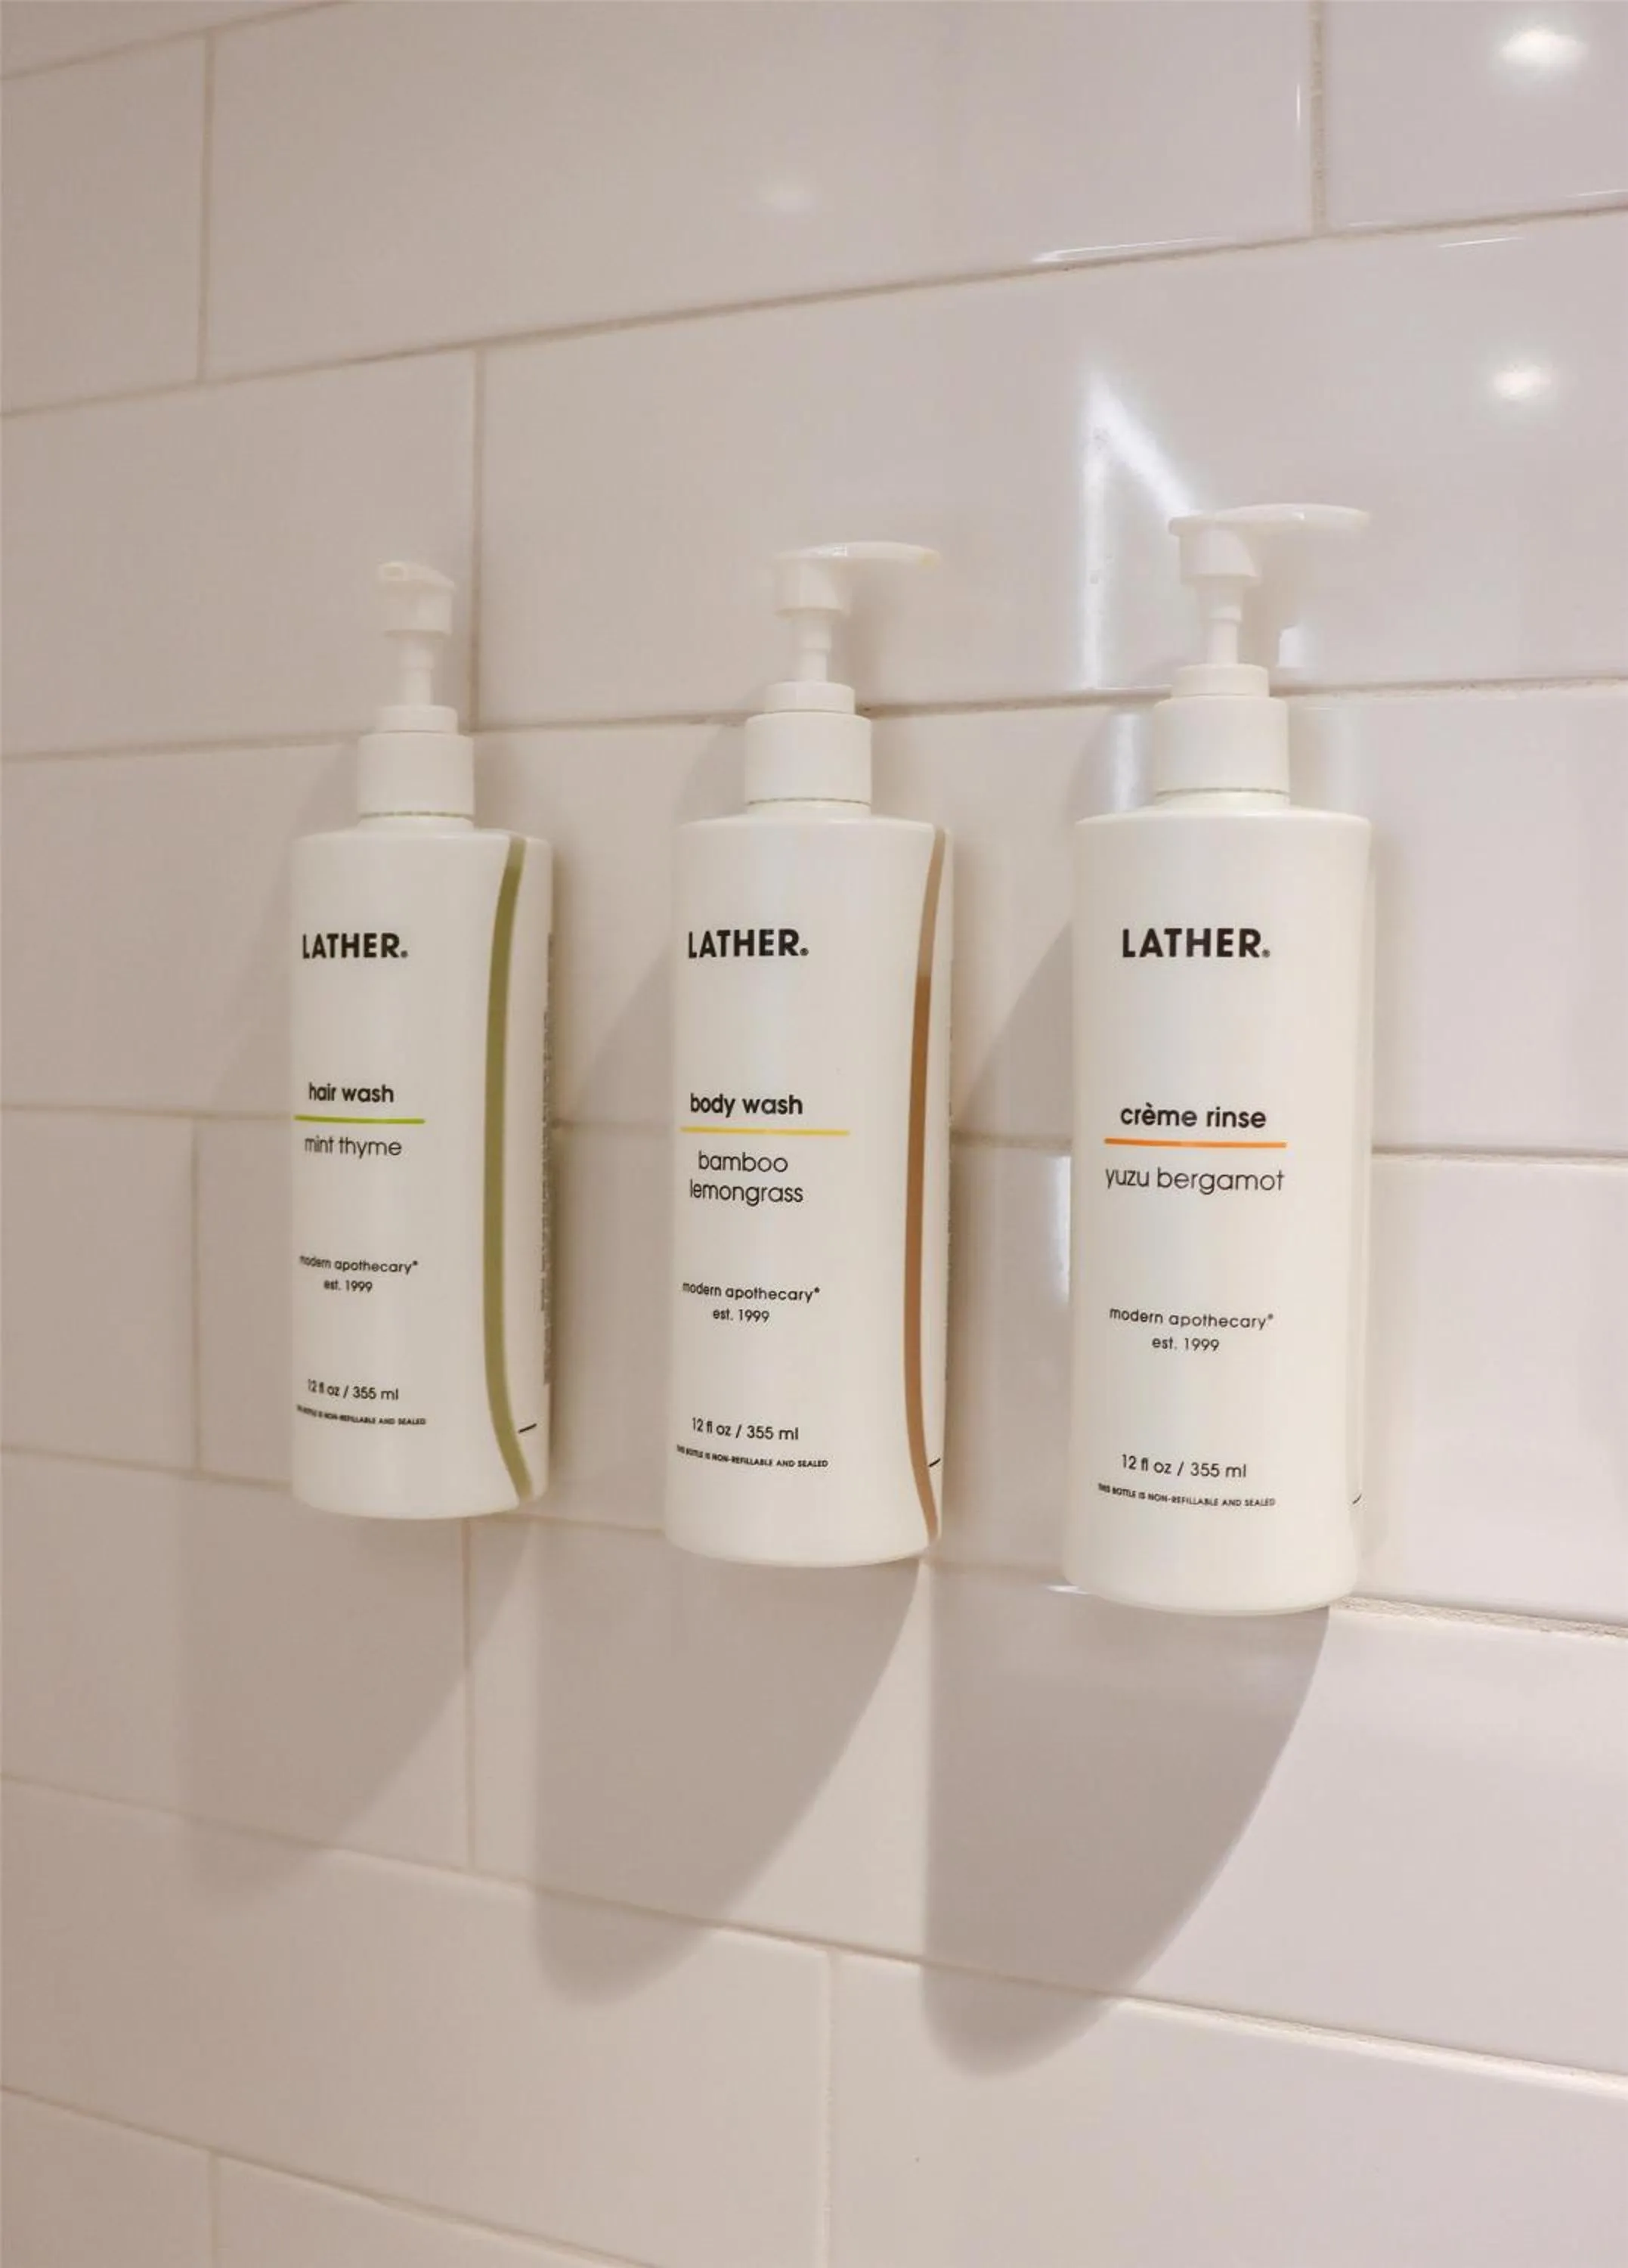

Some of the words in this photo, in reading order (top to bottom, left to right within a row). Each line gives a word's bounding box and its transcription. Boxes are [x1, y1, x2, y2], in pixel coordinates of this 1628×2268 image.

[308, 1082, 337, 1101] hair
[342, 1083, 395, 1103] wash
[690, 1092, 736, 1118] body
[741, 1094, 803, 1115] wash
[1120, 1101, 1198, 1127] crème
[1206, 1106, 1267, 1129] rinse
[305, 1135, 333, 1154] mint
[339, 1137, 402, 1159] thyme
[698, 1151, 788, 1173] bamboo
[1105, 1168, 1150, 1189] yuzu
[1157, 1167, 1285, 1195] bergamot
[689, 1179, 803, 1207] lemongrass
[345, 1280, 373, 1293] 1999
[682, 1281, 722, 1298] modern
[713, 1307, 733, 1321] est.
[738, 1309, 770, 1323] 1999
[1110, 1307, 1163, 1325] modern
[1152, 1336, 1178, 1350] est.
[1184, 1337, 1220, 1352] 1999
[327, 1384, 341, 1397] oz
[352, 1386, 377, 1399] 355
[381, 1388, 399, 1401] ml
[692, 1418, 703, 1432] 12
[716, 1424, 731, 1437] oz
[735, 1424, 742, 1439] /
[747, 1425, 774, 1439] 355
[778, 1427, 799, 1440] ml
[712, 1454, 773, 1467] NON-REFILLABLE
[776, 1459, 795, 1467] AND
[797, 1459, 829, 1467] SEALED
[1122, 1454, 1137, 1470] 12
[1153, 1461, 1171, 1474] oz
[1177, 1461, 1184, 1476] /
[1190, 1462, 1221, 1478] 355
[1225, 1464, 1246, 1478] ml
[1112, 1487, 1135, 1498] BOTTLE
[1147, 1492, 1219, 1507] NON-REFILLABLE
[1221, 1498, 1241, 1507] AND
[1244, 1498, 1276, 1507] SEALED
